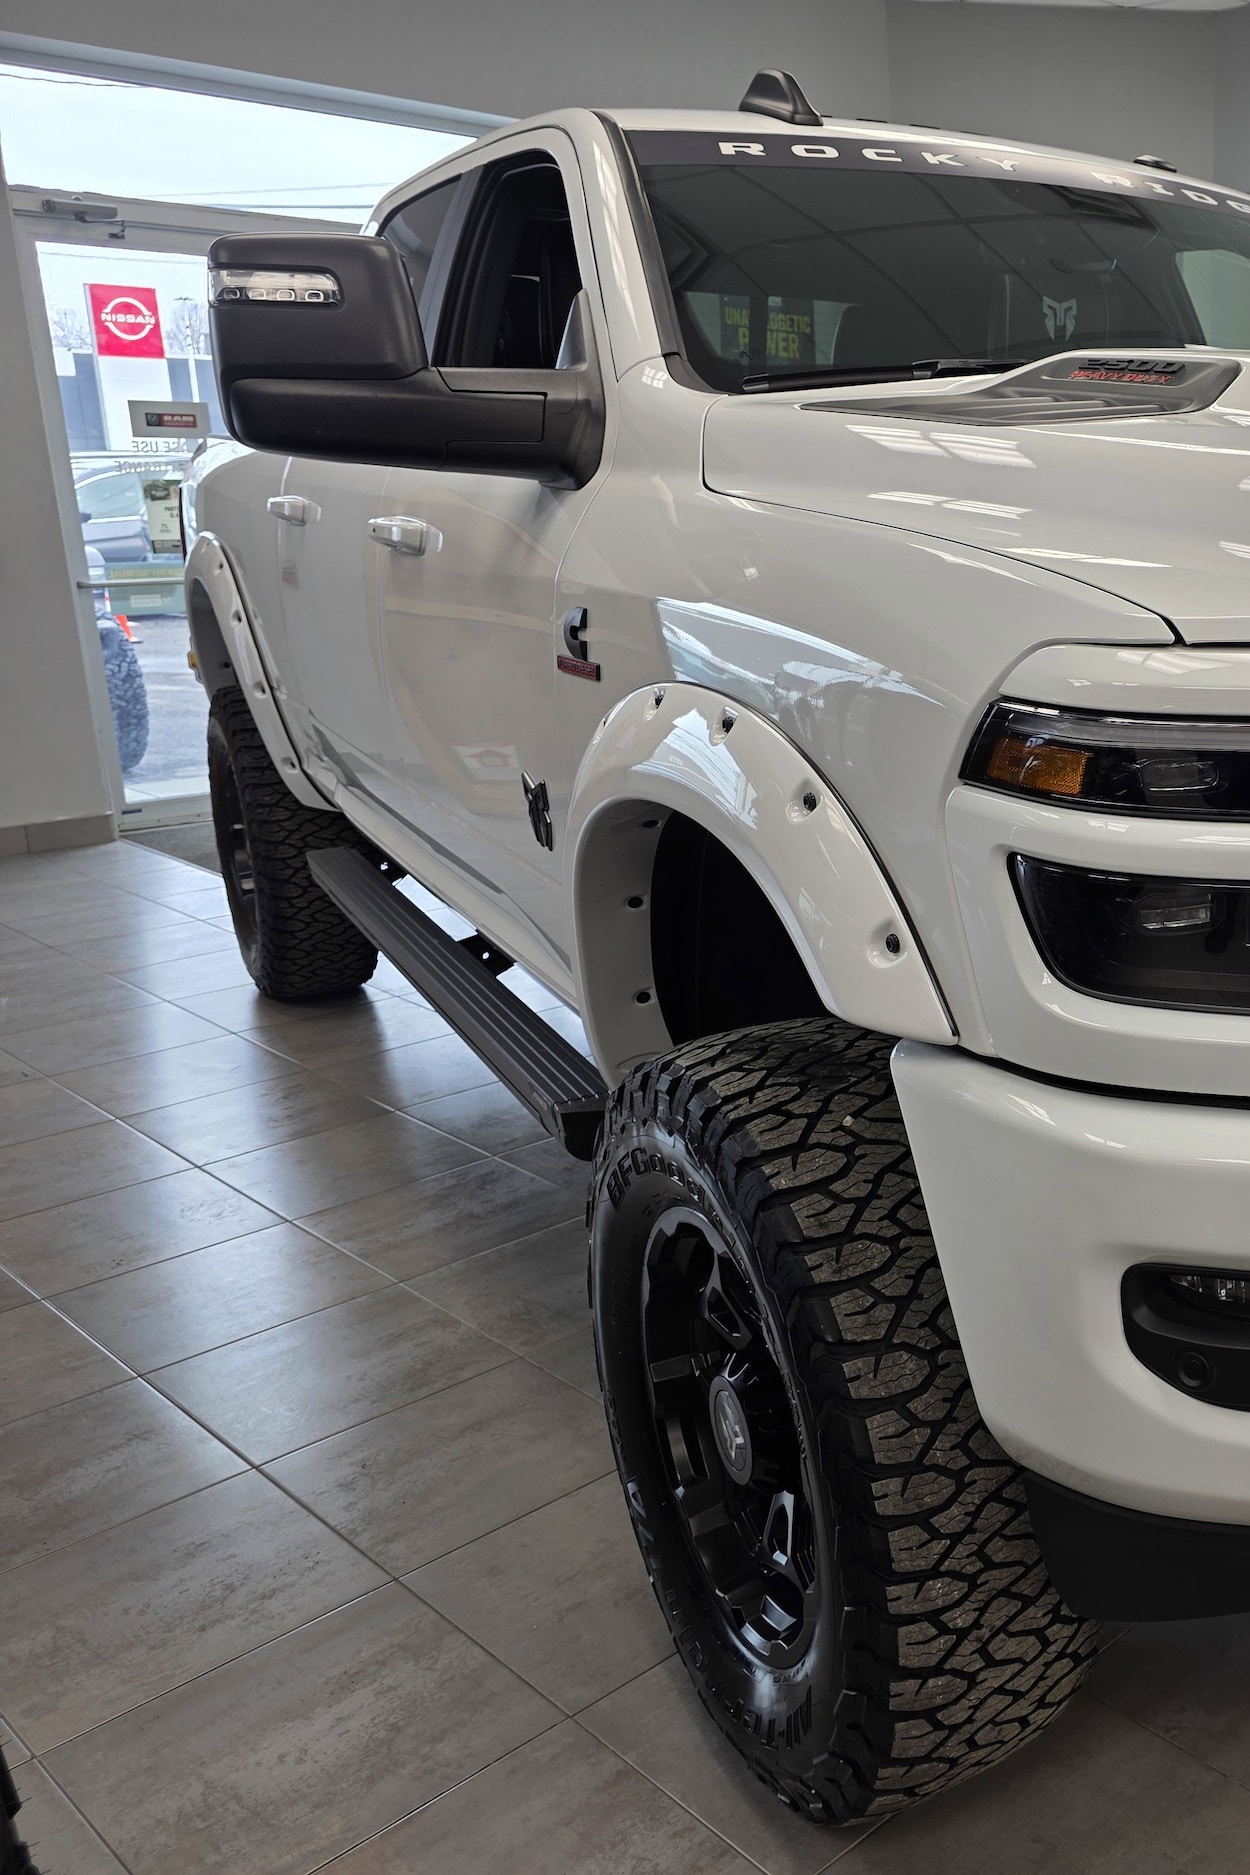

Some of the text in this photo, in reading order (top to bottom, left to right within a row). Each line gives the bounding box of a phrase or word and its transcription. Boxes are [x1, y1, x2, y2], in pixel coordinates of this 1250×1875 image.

[718, 141, 1021, 172] ROCKY
[101, 312, 156, 325] NISSAN
[724, 306, 811, 334] UNAOGETIC
[737, 327, 800, 360] PWER
[1068, 370, 1172, 384] HEAVY DUTY
[1078, 359, 1186, 375] 2500
